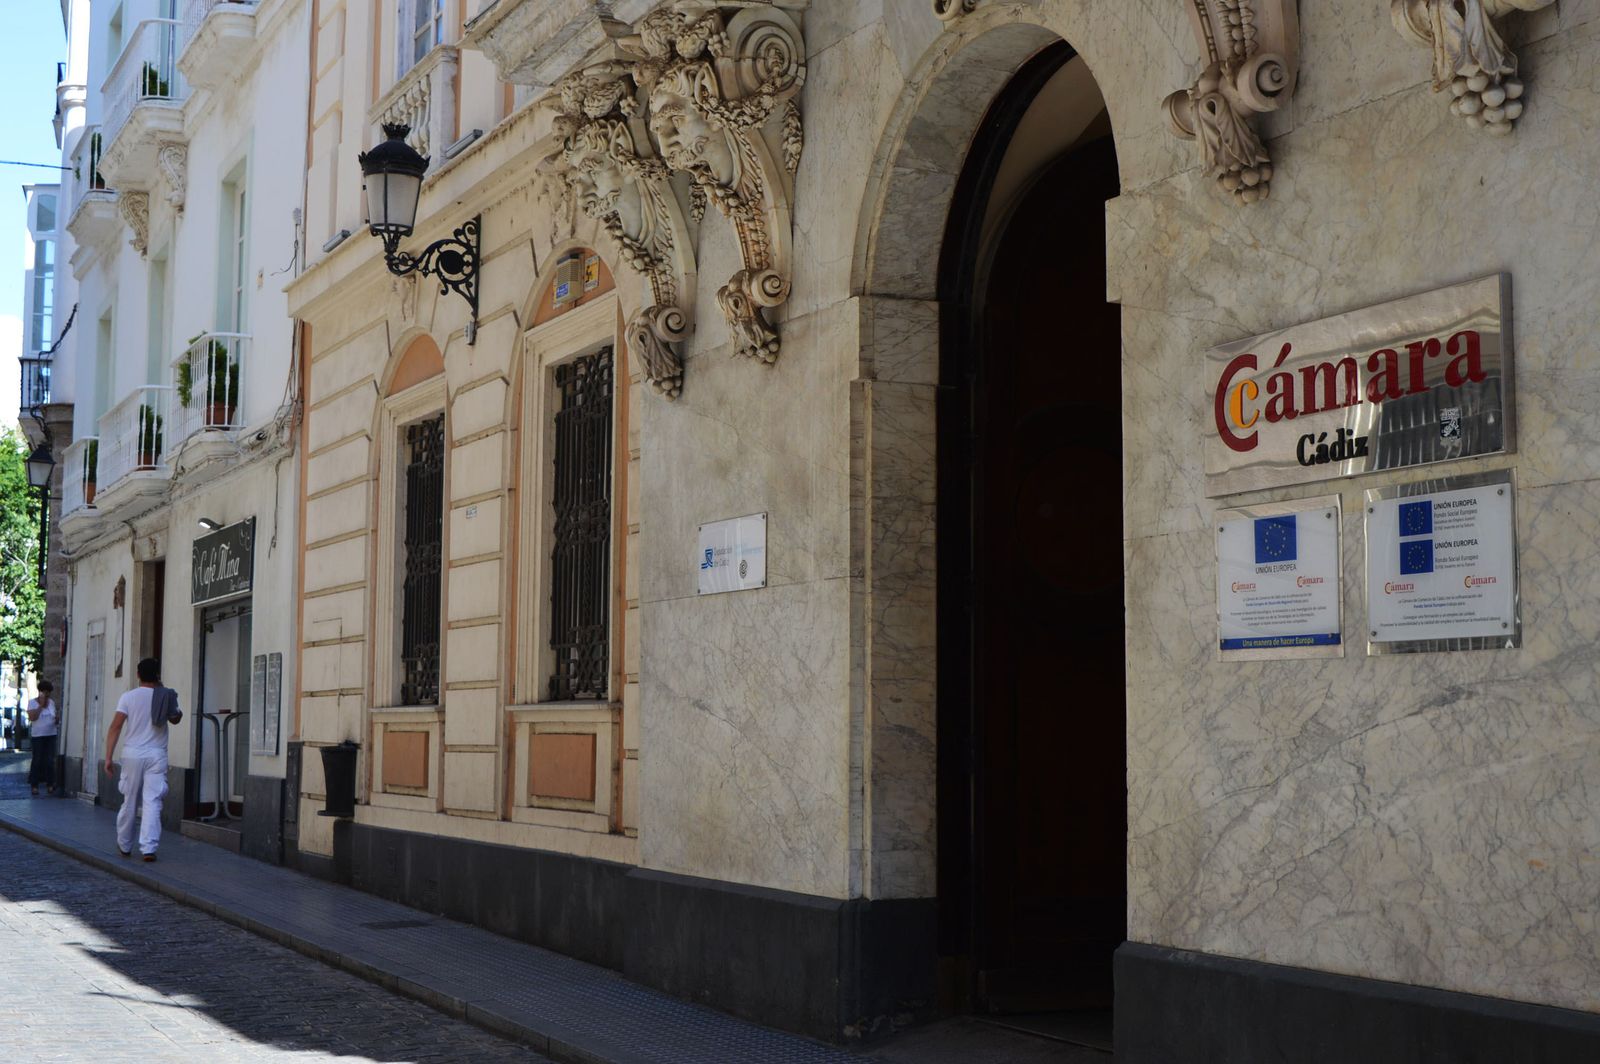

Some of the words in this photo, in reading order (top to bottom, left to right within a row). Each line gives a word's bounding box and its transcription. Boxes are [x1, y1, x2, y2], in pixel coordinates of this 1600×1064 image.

[1297, 428, 1369, 466] Cádiz
[1434, 500, 1451, 510] UNIÓN
[1453, 499, 1477, 508] EUROPEA
[1435, 541, 1452, 549] UNIÓN
[1453, 539, 1478, 548] EUROPEA
[1255, 564, 1272, 574] UNIÓN
[1273, 563, 1297, 573] EUROPEA
